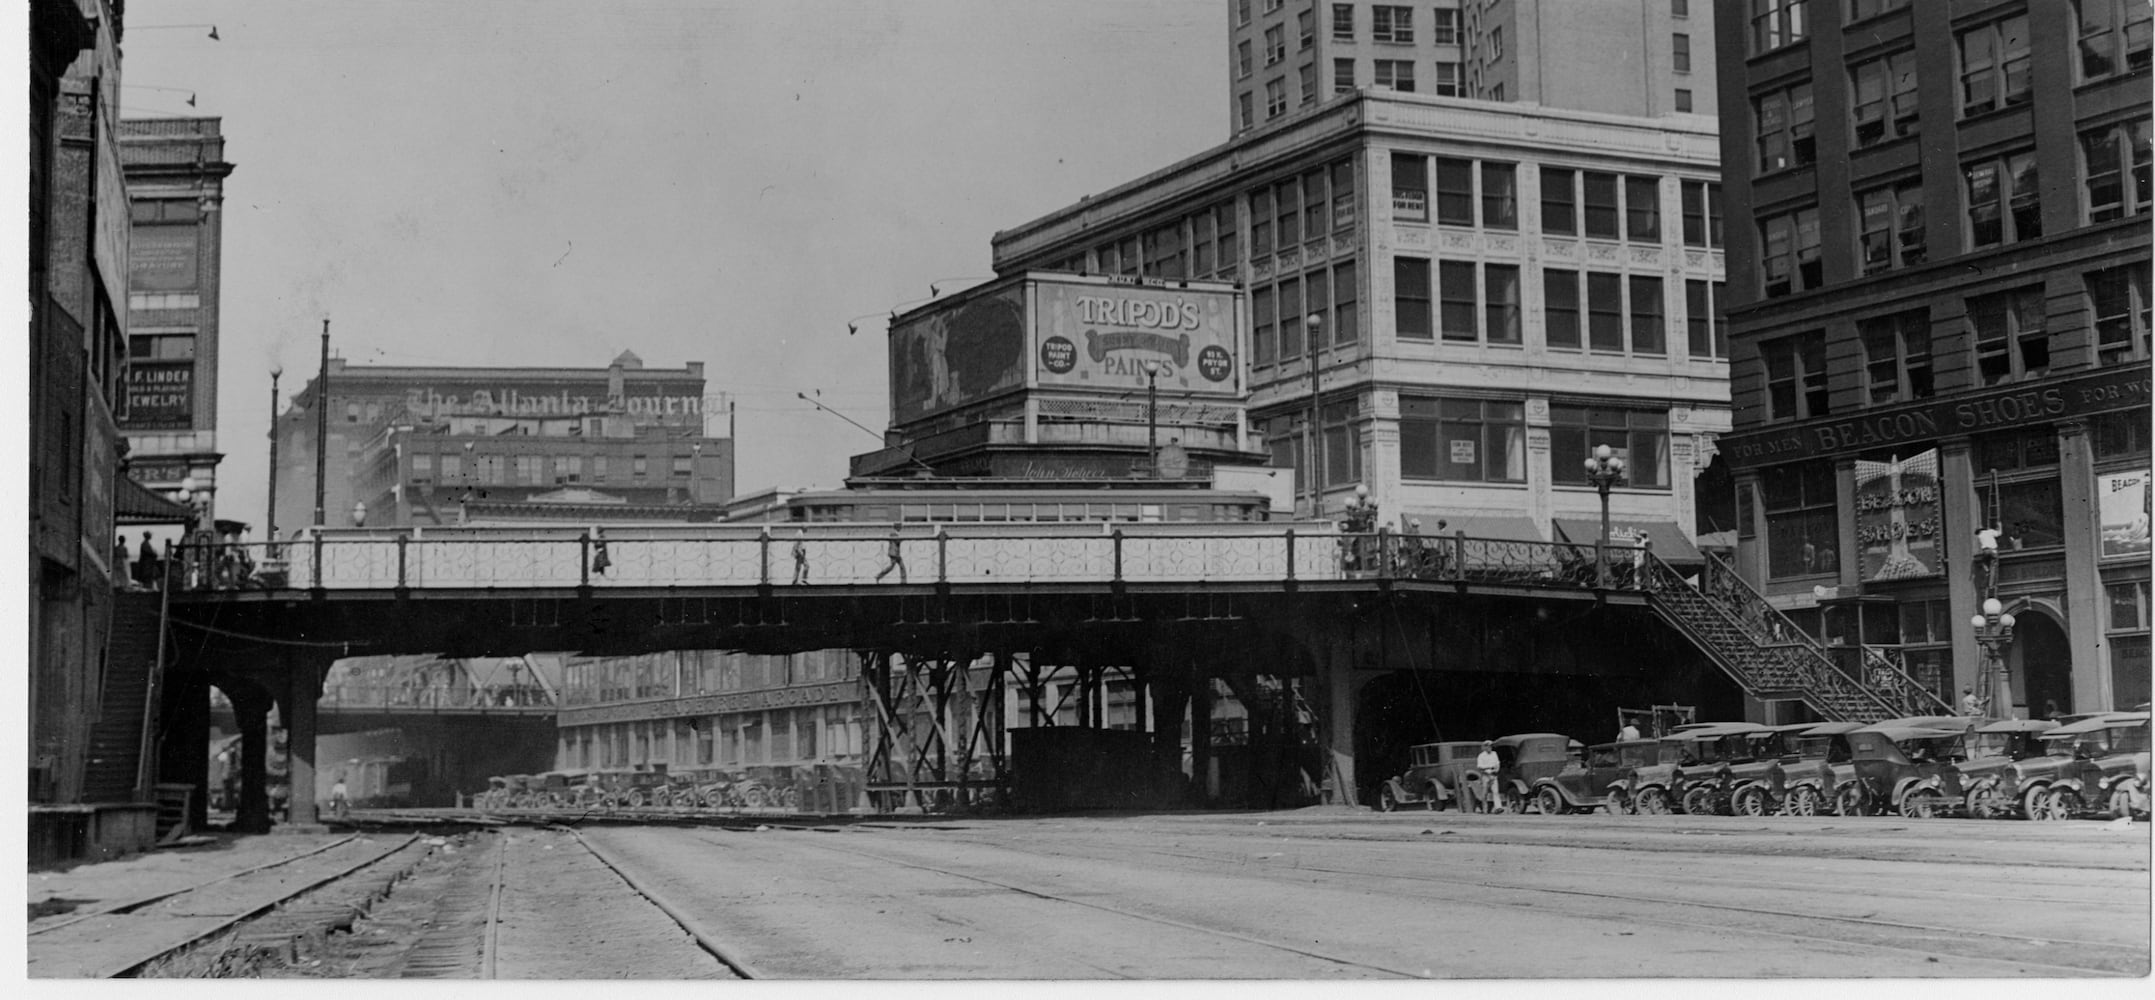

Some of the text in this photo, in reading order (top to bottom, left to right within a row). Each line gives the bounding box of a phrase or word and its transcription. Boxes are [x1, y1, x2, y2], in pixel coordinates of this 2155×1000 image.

[1408, 202, 1423, 210] RENT
[1076, 296, 1200, 330] TRIPOD'S
[1046, 342, 1073, 352] TRIPOD
[1048, 351, 1070, 360] PAINT
[147, 370, 189, 383] LINDER
[407, 387, 727, 416] The Atlanta Journal
[1732, 443, 1765, 460] FOR
[1768, 436, 1802, 453] MEN
[1816, 409, 1938, 451] BEACON
[1956, 388, 2065, 428] SHOES
[2081, 385, 2120, 405] FOR
[128, 467, 182, 480] ER'S
[1861, 486, 1934, 510] BEACON
[1862, 518, 1935, 543] SHOES
[761, 686, 839, 708] ARCADE
